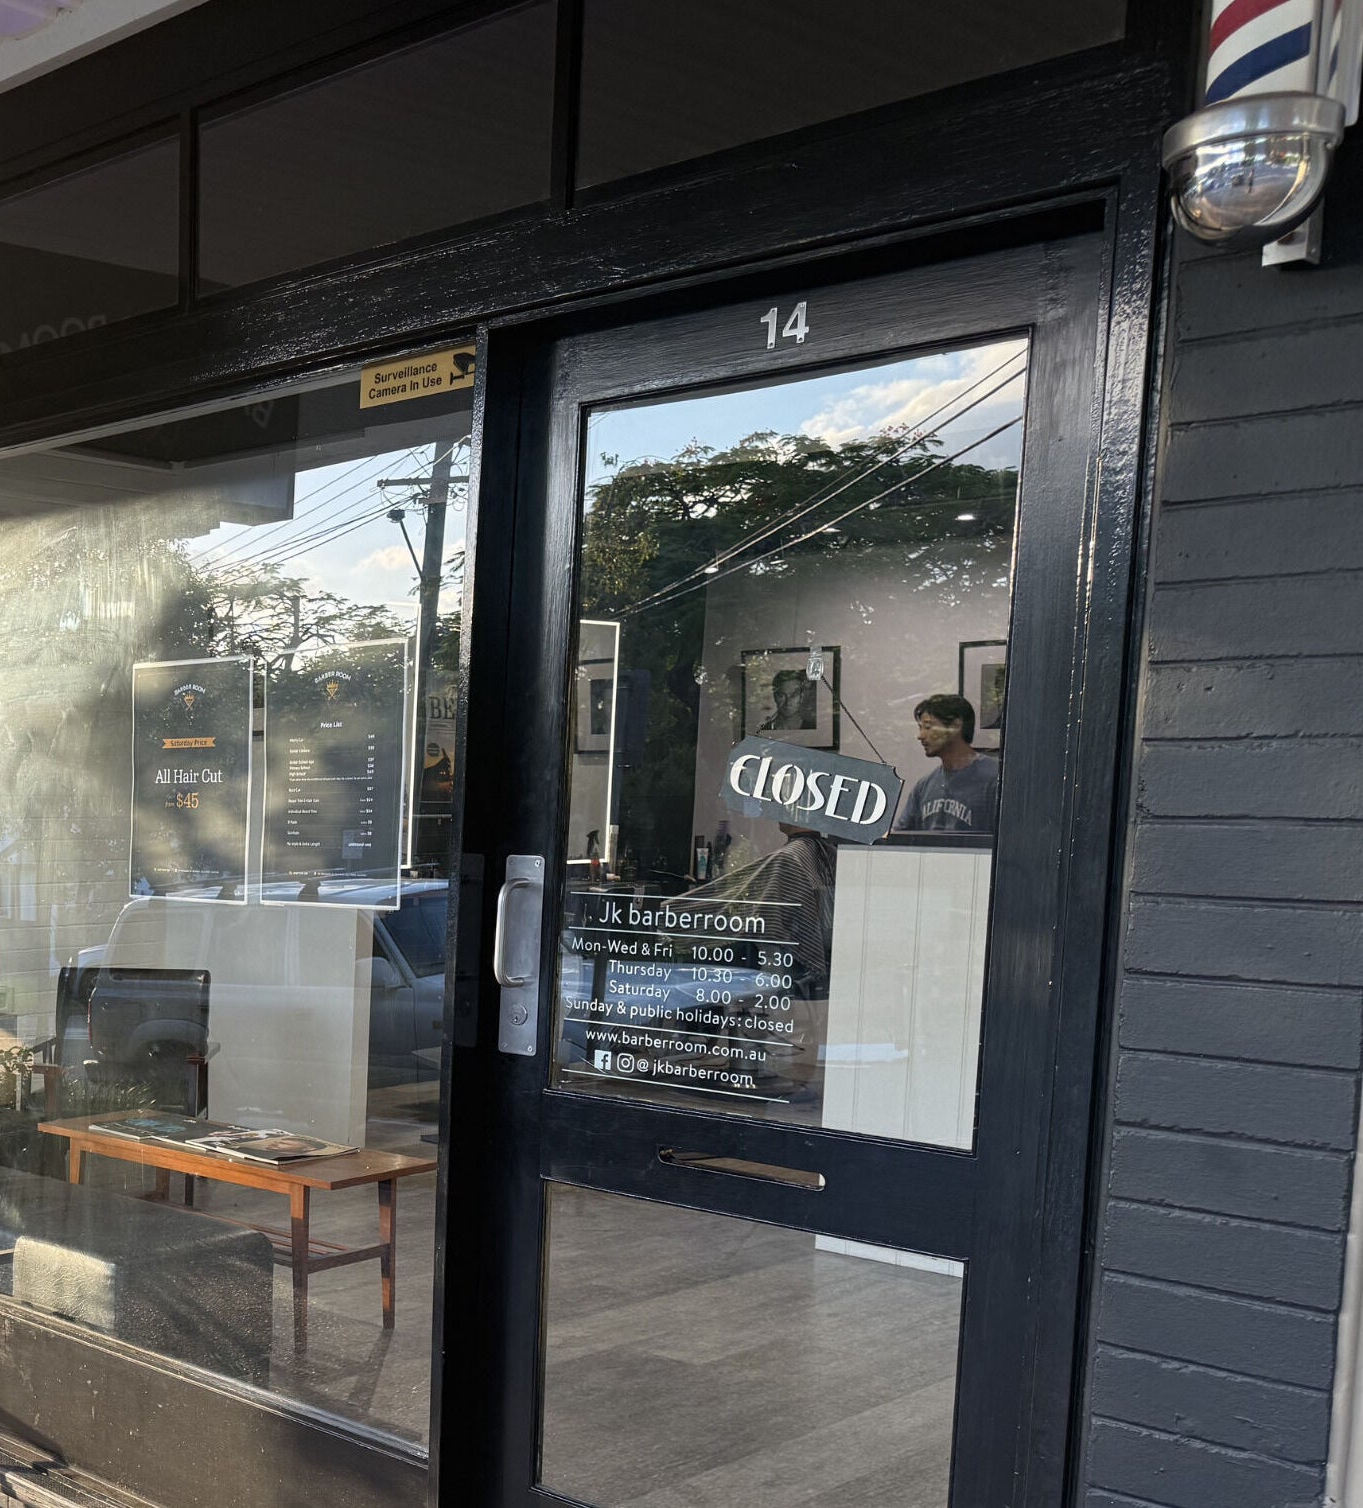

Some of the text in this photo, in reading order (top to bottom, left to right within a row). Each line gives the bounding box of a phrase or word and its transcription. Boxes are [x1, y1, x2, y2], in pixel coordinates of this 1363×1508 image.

[760, 301, 809, 349] 14
[368, 375, 443, 400] Camera In Use
[374, 362, 438, 384] Surveillance
[155, 768, 224, 784] All Hair Cut
[730, 754, 887, 825] CLOSED
[176, 792, 200, 809] $45
[922, 798, 972, 827] ALIFORNIA
[599, 901, 766, 934] Jk barberroom
[571, 936, 638, 955] Mon-Wed
[640, 942, 651, 957] &
[654, 942, 673, 958] Fri
[691, 946, 734, 963] 10.00
[757, 950, 794, 968] 5.30
[608, 959, 672, 982] Thursday
[692, 967, 733, 984] 10.30
[755, 972, 792, 989] 6.00
[608, 979, 671, 1002] Saturday
[696, 988, 732, 1005] 8.00
[754, 993, 791, 1011] 2.00
[565, 996, 613, 1016] Sunday
[616, 1000, 627, 1015] &
[629, 1003, 672, 1020] public
[744, 1015, 794, 1033] closed
[585, 1029, 767, 1062] www.barberroom.com.au
[652, 1059, 753, 1085] jkbarberroom
